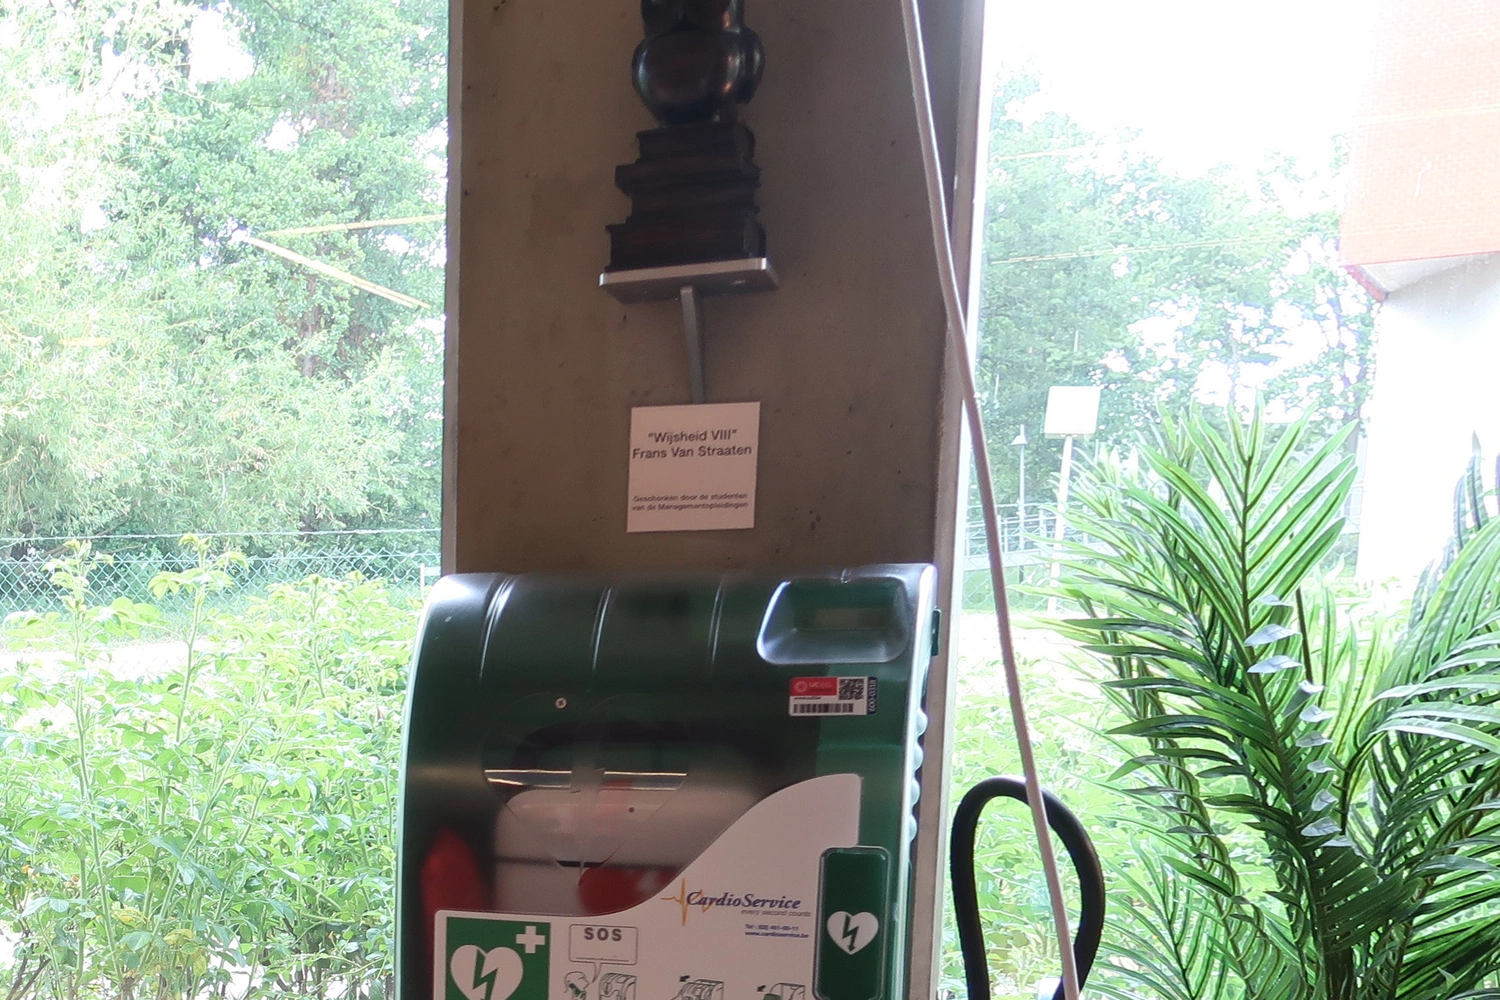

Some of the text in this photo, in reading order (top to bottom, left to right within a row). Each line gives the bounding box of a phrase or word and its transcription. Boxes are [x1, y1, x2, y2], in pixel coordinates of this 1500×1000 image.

[632, 445, 752, 459] Frans Van Straaten
[686, 890, 801, 909] CardioService
[584, 927, 622, 942] SOS
